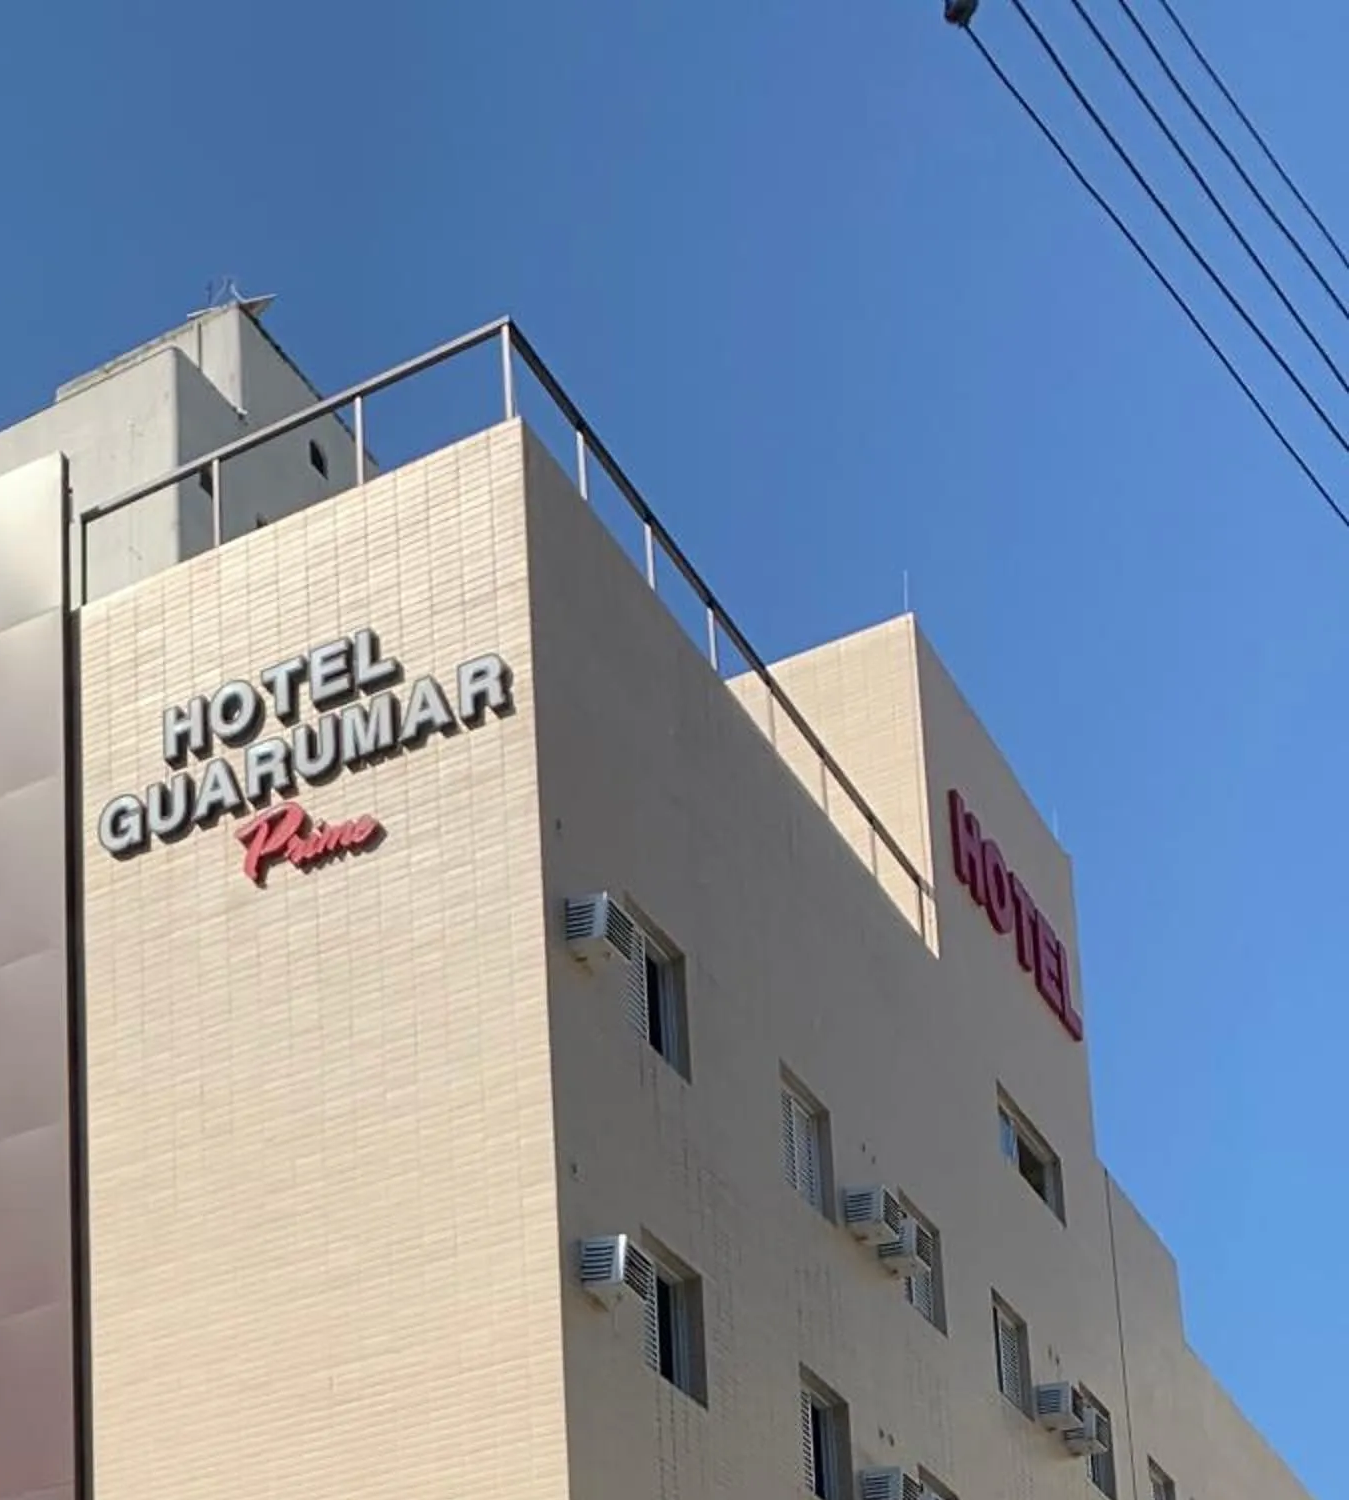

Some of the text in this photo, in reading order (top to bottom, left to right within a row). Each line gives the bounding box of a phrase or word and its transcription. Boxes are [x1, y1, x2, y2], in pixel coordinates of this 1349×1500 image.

[98, 652, 514, 862] GUARUMAR
[163, 628, 403, 768] HOTEL
[235, 801, 387, 888] Prime
[948, 789, 1083, 1042] HOTEL
